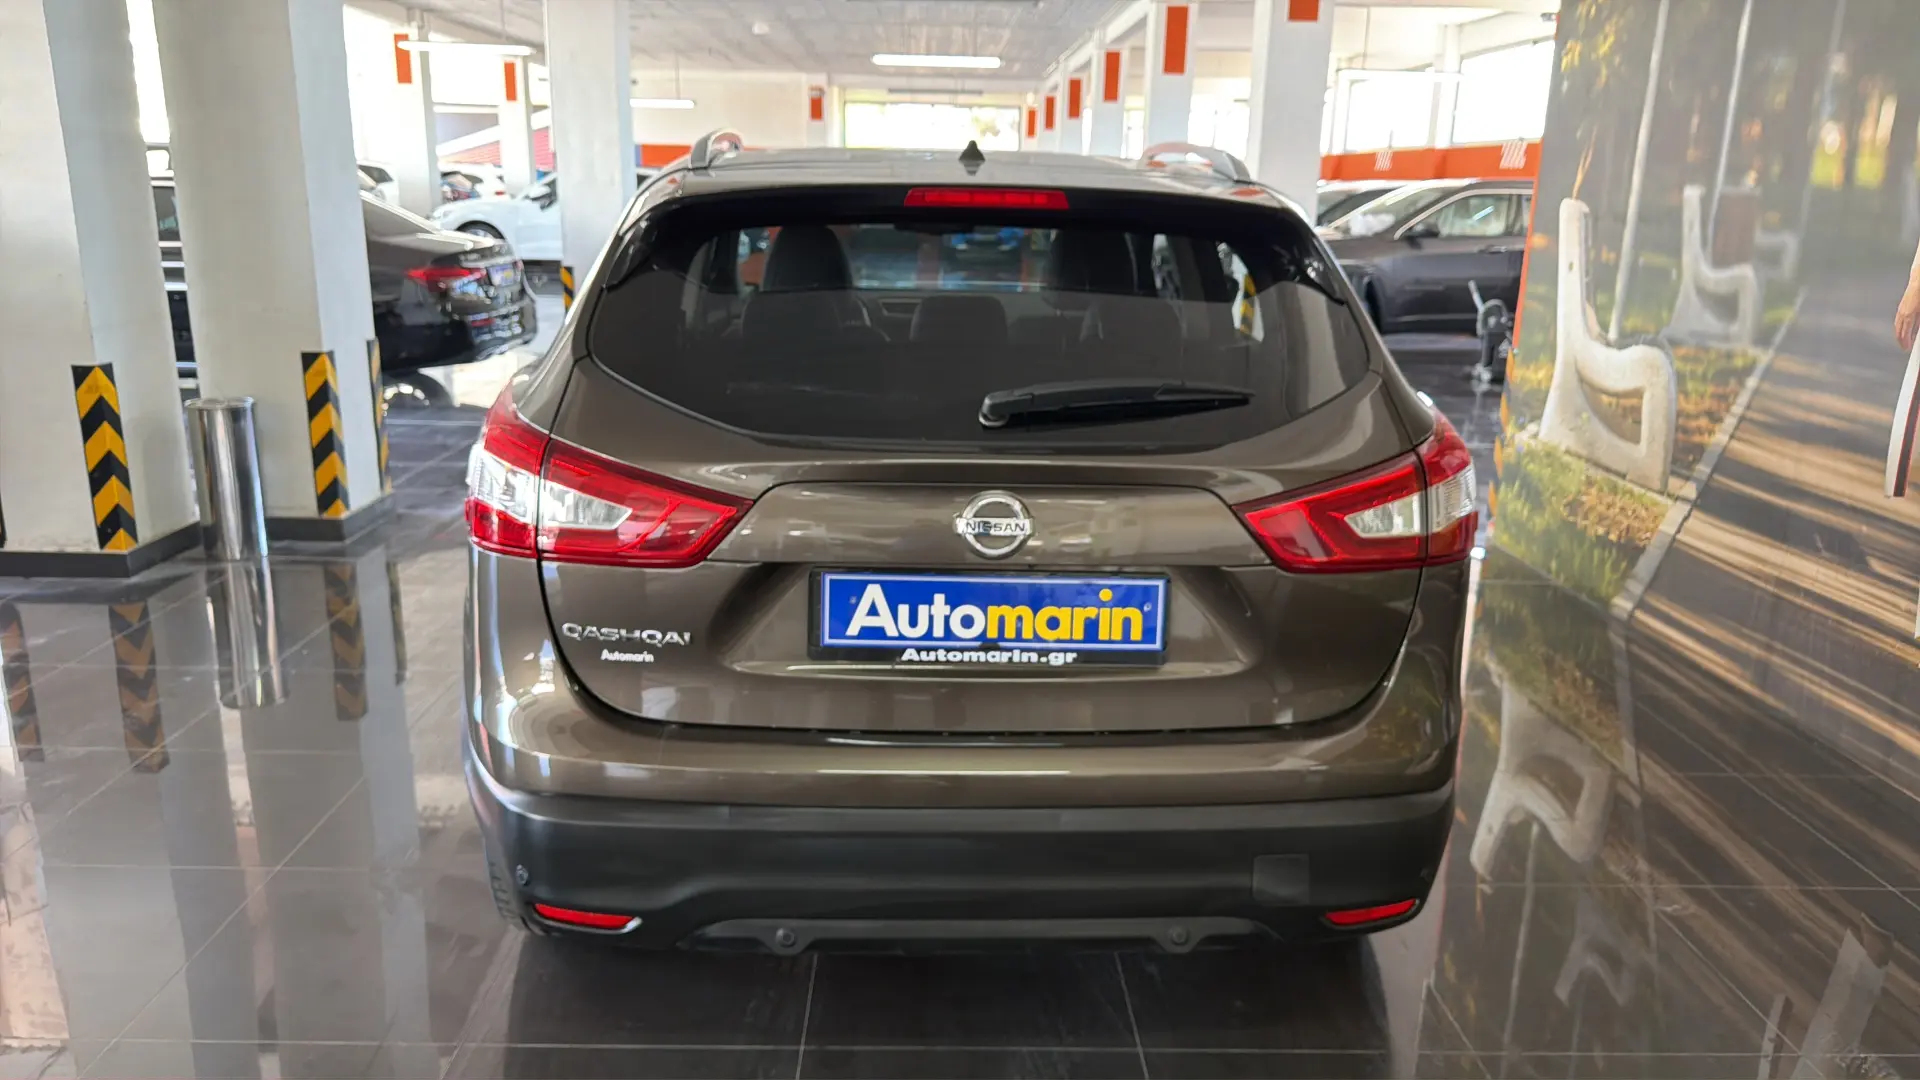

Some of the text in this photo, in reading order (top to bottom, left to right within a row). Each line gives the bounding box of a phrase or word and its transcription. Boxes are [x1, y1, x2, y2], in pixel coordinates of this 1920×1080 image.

[966, 521, 1025, 532] NISSAN
[845, 583, 1144, 641] Automarin
[562, 622, 691, 647] QASHQAI
[600, 648, 655, 662] Automarin
[900, 647, 1078, 666] Automarin.gr
